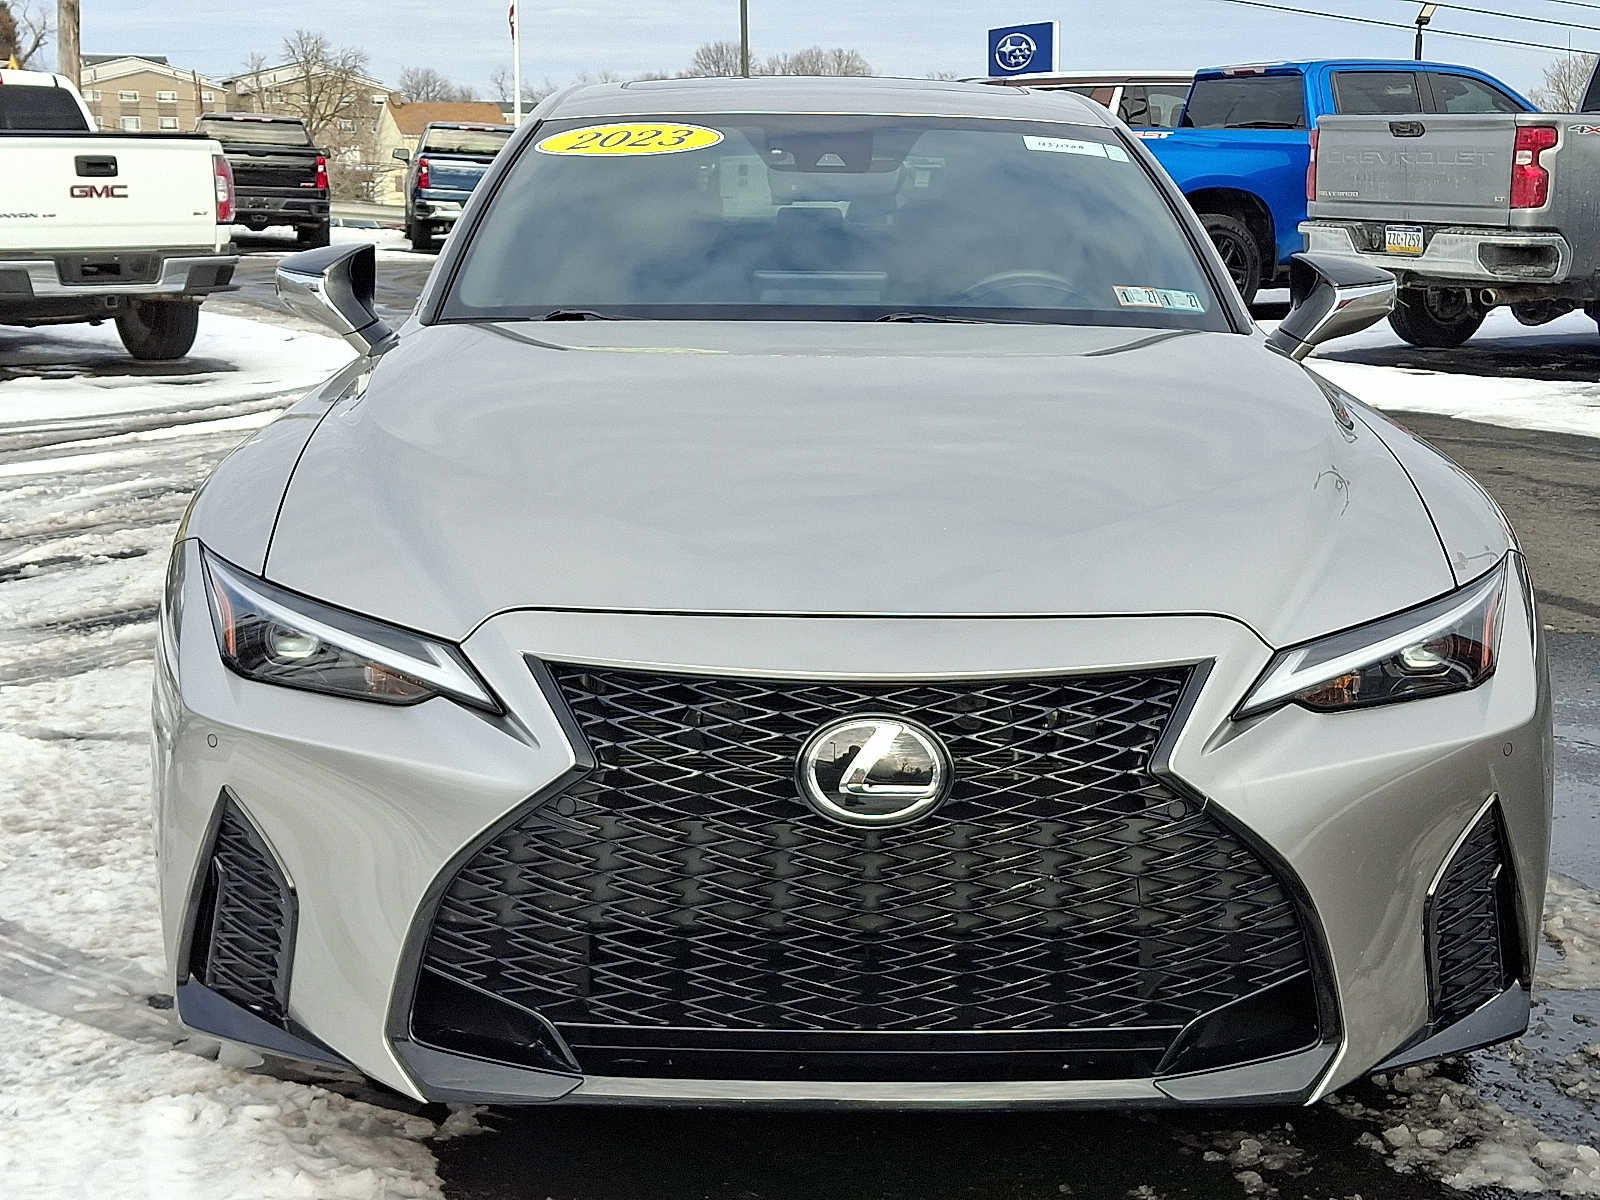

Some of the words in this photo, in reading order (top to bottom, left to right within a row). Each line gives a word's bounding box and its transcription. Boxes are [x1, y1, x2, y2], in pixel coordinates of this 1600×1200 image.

[566, 130, 694, 150] 2023
[1326, 151, 1496, 167] CHEVROLET
[70, 185, 128, 198] GMC
